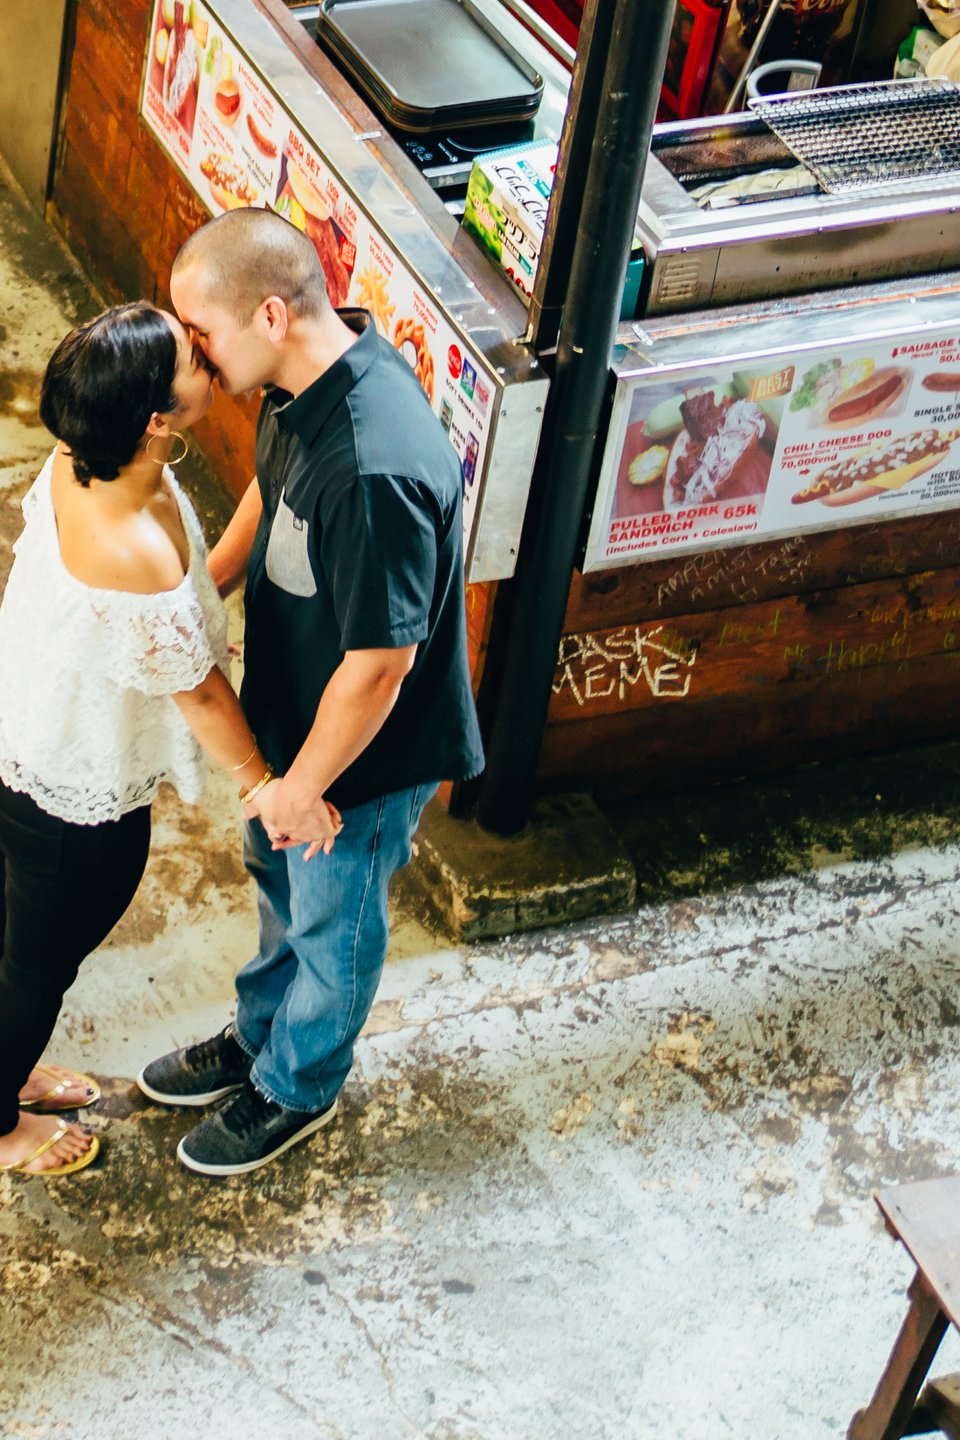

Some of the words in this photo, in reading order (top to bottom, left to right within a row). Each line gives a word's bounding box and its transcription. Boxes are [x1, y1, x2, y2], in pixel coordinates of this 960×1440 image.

[288, 129, 304, 158] BBQ
[307, 152, 321, 177] SET
[900, 338, 955, 355] SAUSAGE
[913, 405, 953, 418] SINGLE
[783, 442, 815, 455] CHILI
[818, 433, 864, 449] CHEESE
[867, 429, 893, 441] DOG
[611, 514, 671, 533] PULLED
[677, 505, 719, 521] PORK
[723, 503, 757, 520] 65k
[606, 539, 657, 557] (includes
[662, 535, 688, 546] Corn
[702, 522, 758, 539] Coleslaw)
[608, 520, 693, 544] SANDWICH
